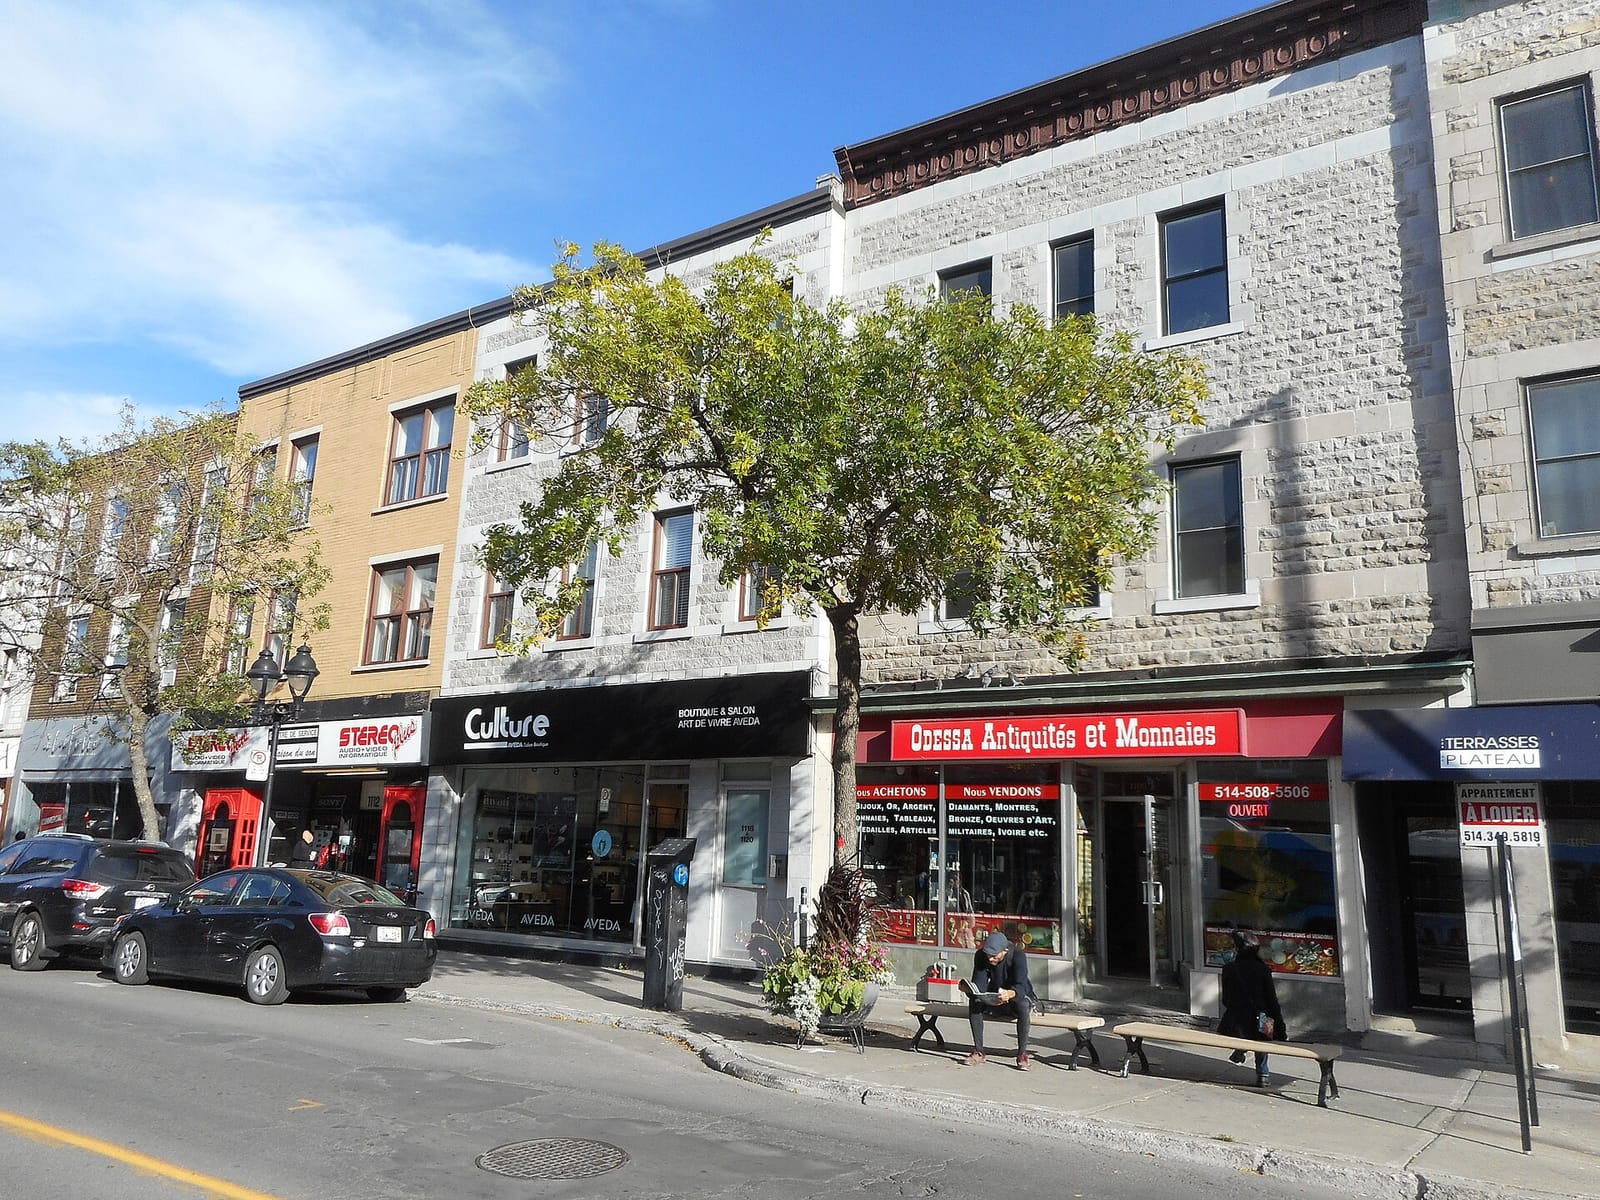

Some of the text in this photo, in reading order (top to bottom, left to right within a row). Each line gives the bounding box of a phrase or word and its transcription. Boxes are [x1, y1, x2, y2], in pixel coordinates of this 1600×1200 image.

[679, 705, 756, 718] BOUTIQUE & SALON
[464, 706, 550, 740] Culture
[678, 716, 760, 729] ART DE VIVRE AVEDA
[339, 724, 400, 747] STEREO
[981, 722, 1077, 753] Antiquités
[1085, 720, 1107, 747] et
[1115, 718, 1217, 748] Monnaies
[1445, 736, 1539, 749] TERRASSES
[1446, 754, 1535, 765] PLATEAU
[873, 787, 927, 797] ACHETONS
[989, 786, 1042, 797] VENDONS
[1215, 786, 1310, 798] 514-508-5506
[1461, 788, 1536, 799] APPARTEMENT
[856, 803, 936, 812] BIJOUX, OR, ARGENT,
[948, 803, 1039, 812] DIAMANTS, MONTRES,
[1229, 804, 1269, 817] OUVERT
[1466, 803, 1536, 823] À LOUER
[856, 814, 936, 823] ONNAIES, TABLEAUX,
[948, 815, 983, 824] BRONZE,
[985, 815, 1024, 823] OEUVRES
[900, 826, 937, 834] ARTICLES
[948, 827, 1048, 837] MILITAIRES, IVOIRE etc.
[464, 911, 495, 922] AVEDA
[520, 914, 555, 926] AVEDA
[584, 918, 621, 931] AVEDA
